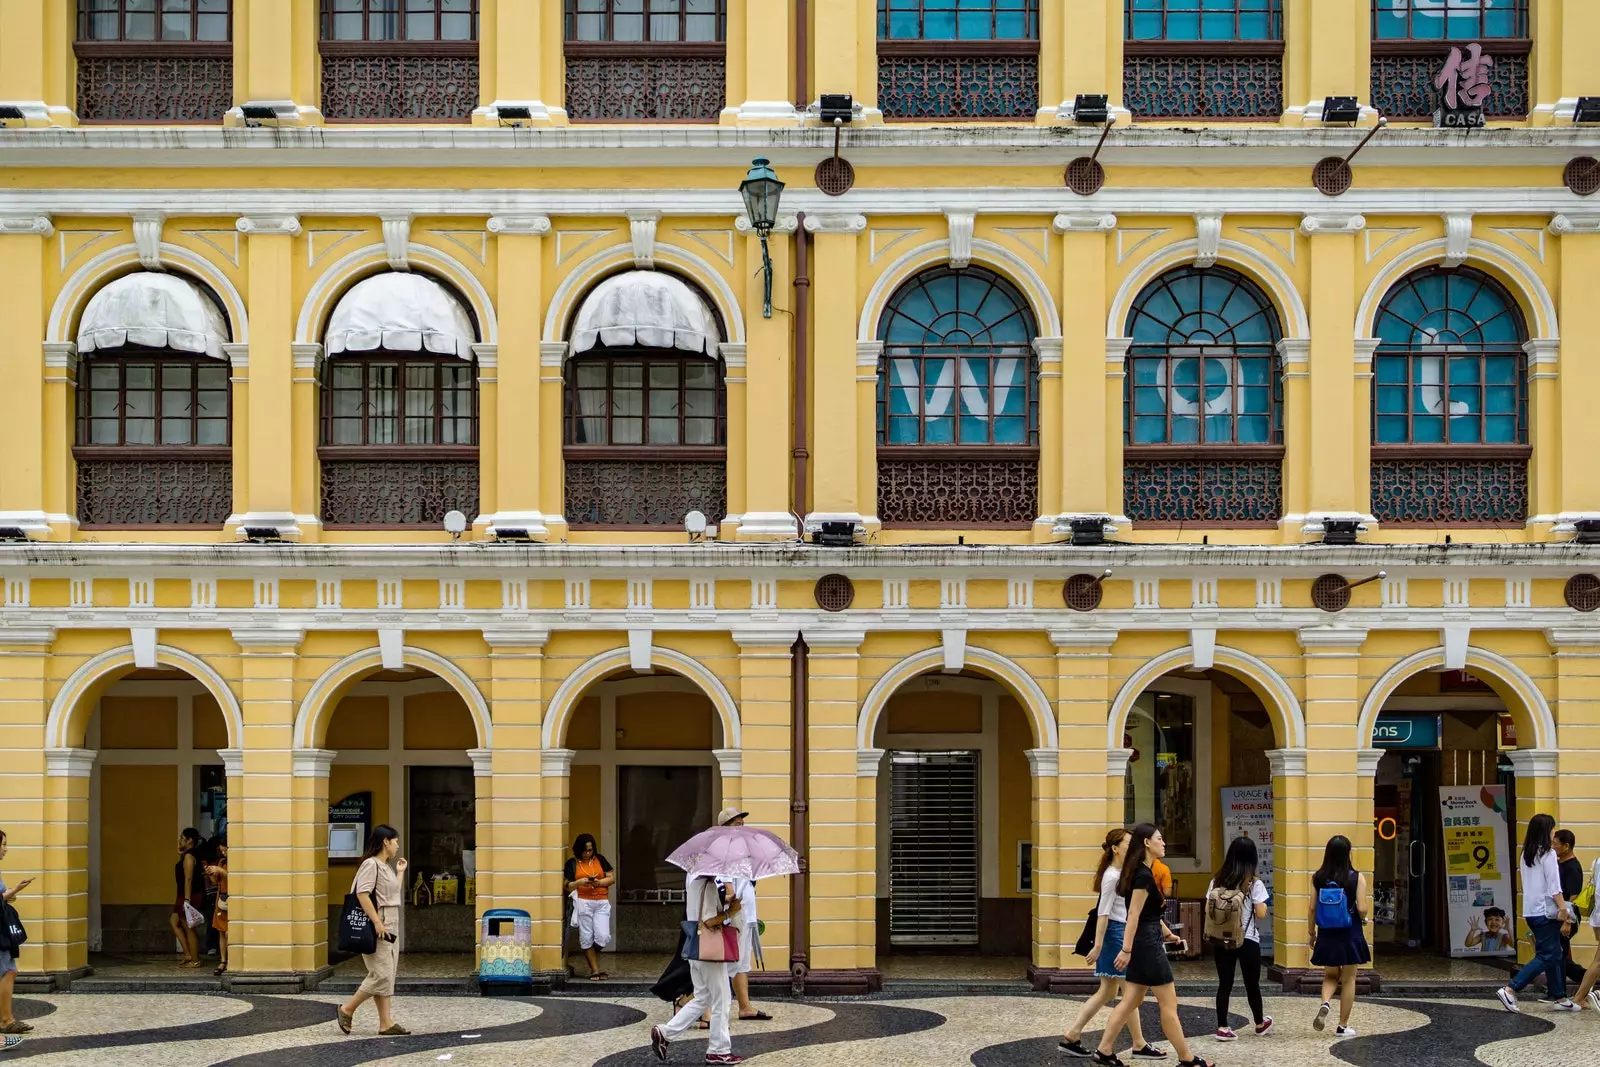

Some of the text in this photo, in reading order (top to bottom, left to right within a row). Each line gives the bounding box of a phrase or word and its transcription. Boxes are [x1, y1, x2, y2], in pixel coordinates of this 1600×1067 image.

[1434, 43, 1493, 109] 信
[1445, 113, 1486, 126] CASA
[1233, 789, 1263, 799] URIAGE
[1231, 803, 1255, 811] MEGA
